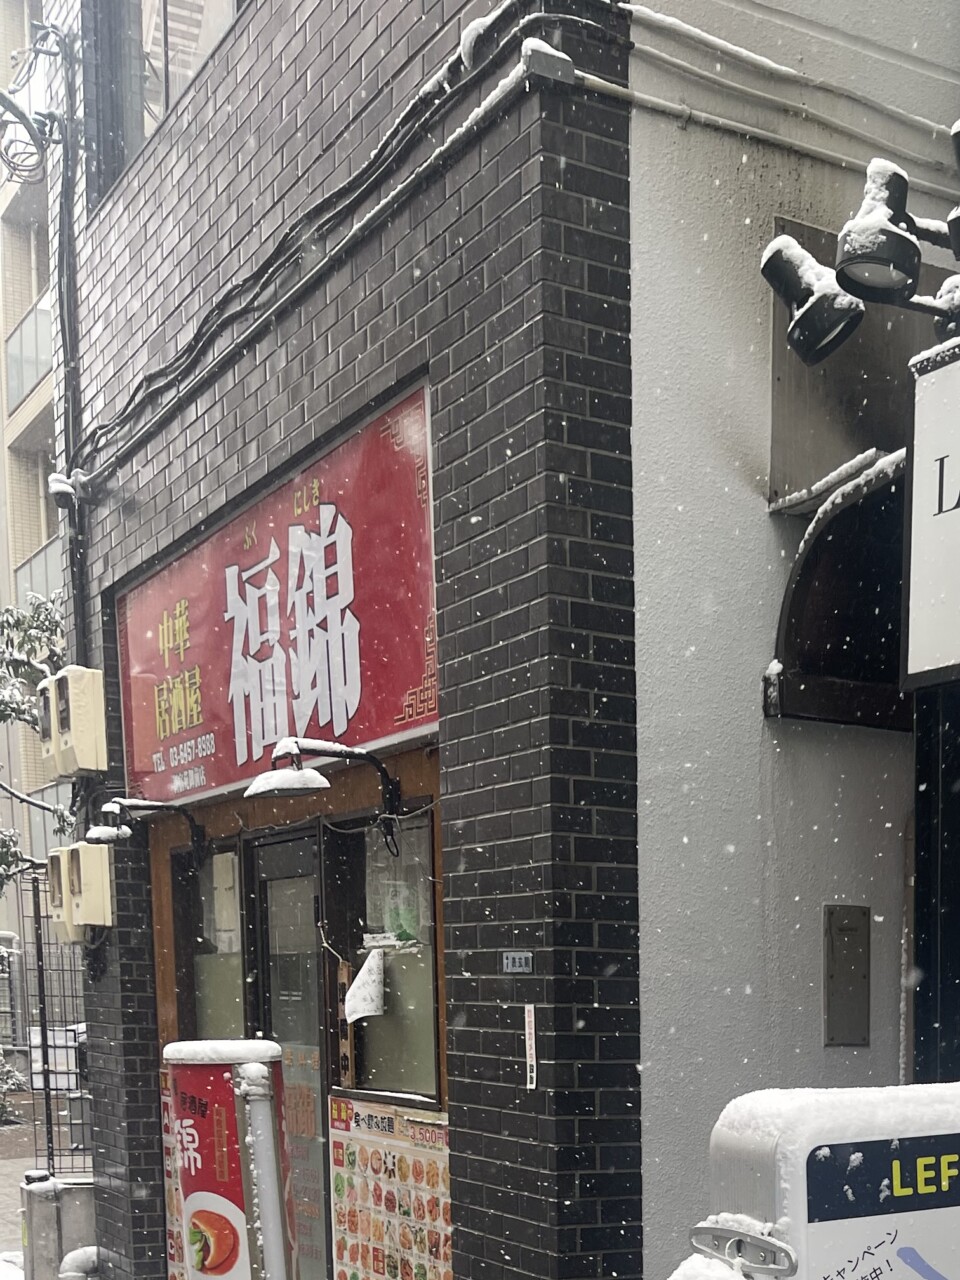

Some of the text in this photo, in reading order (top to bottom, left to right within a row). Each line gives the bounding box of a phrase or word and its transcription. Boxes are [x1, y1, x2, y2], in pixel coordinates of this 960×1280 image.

[158, 598, 191, 669] 中華
[153, 663, 204, 741] 居酒屋
[152, 751, 166, 773] TEL
